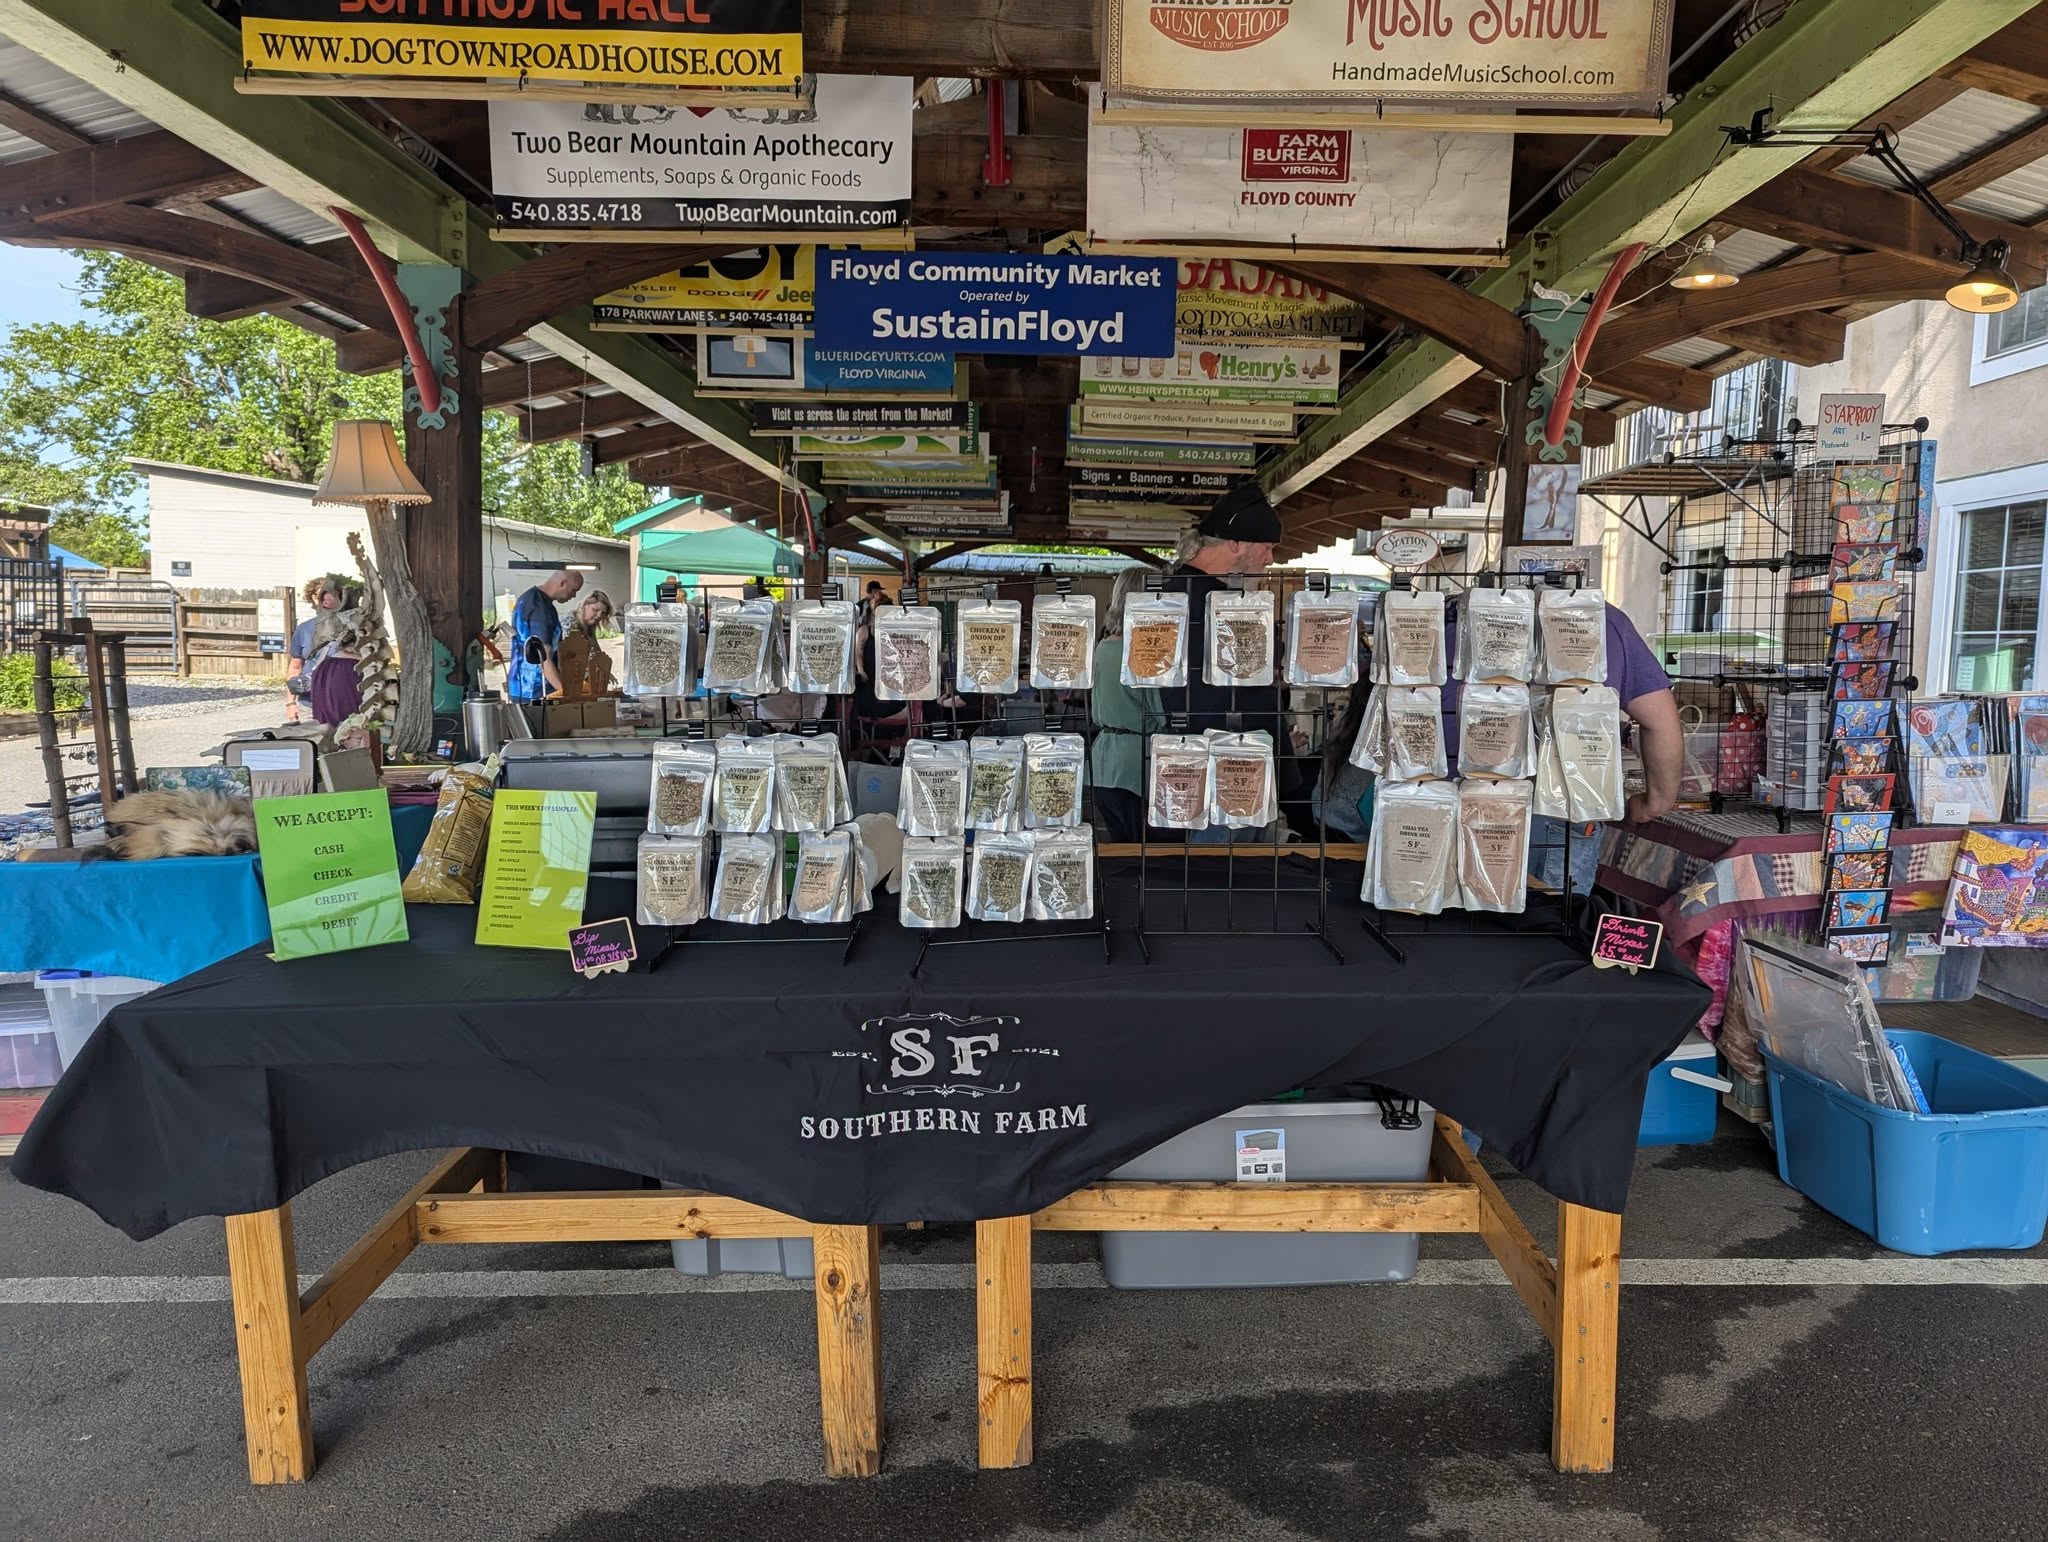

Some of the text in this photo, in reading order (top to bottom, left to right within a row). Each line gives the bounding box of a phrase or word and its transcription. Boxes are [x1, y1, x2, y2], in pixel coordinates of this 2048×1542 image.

[1155, 9, 1287, 40] MUSIC SCHOOL
[1346, 0, 1608, 50] MUSIC SCHOOL
[258, 33, 783, 76] WWW.DOGTOWNROADHOUSE.COM
[1332, 62, 1615, 85] HandmadeMusicSchool.com
[512, 131, 893, 164] Two Bear Mountain Apothecary
[1279, 134, 1338, 148] FARM
[1253, 149, 1339, 162] BUREAU
[546, 167, 862, 190] Supplements, Soaps & Organic Foods
[1281, 166, 1338, 175] VIRGINIA
[1241, 192, 1356, 207] FLOYD COUNTY
[511, 202, 896, 225] 540.835.4718 TwoBearMountain.com
[830, 259, 1161, 289] Floyd Community Market
[688, 290, 757, 298] DODGE
[959, 290, 1029, 305] Operated by
[1206, 293, 1304, 313] Movement & Magic
[600, 307, 803, 322] 178 PARKWAY LANE S. 540-745-4184
[1176, 309, 1358, 333] OYDYOGAJAM.NET
[872, 307, 1124, 350] SustainFloyd
[814, 350, 946, 362] BLUERIDGEYURTS.COM
[839, 368, 926, 380] FLOYD VIRGINIA
[1221, 354, 1296, 383] Henry's
[1099, 384, 1220, 397] WWW.HENRYSPETS.COM
[772, 408, 953, 421] Visit us across the street from the Market!
[1091, 410, 1122, 420] Certified
[1124, 412, 1151, 424] Organic
[1153, 413, 1185, 424] Produce,
[1187, 414, 1213, 424] Pasture
[1215, 416, 1239, 425] Raised
[1240, 417, 1260, 426] Meat
[1268, 418, 1286, 428] Eggs
[1824, 404, 1881, 426] STARROOT
[1832, 426, 1846, 434] ART
[1821, 440, 1849, 448] Postcards
[1071, 445, 1250, 461] thomaswallre.com 540.745.8973
[1081, 469, 1228, 486] Signs Banners Decals
[273, 807, 373, 828] WE ACCEPT:
[314, 844, 345, 855] CASH
[313, 868, 352, 880] CHECK
[315, 892, 358, 905] CREDIT
[322, 917, 358, 930] DEBIT
[1602, 919, 1648, 937] Drink
[573, 930, 599, 946] Dip
[1603, 933, 1648, 949] Mixes
[584, 943, 620, 956] Mixes
[800, 1104, 1088, 1140] SOUTHERN FARM
